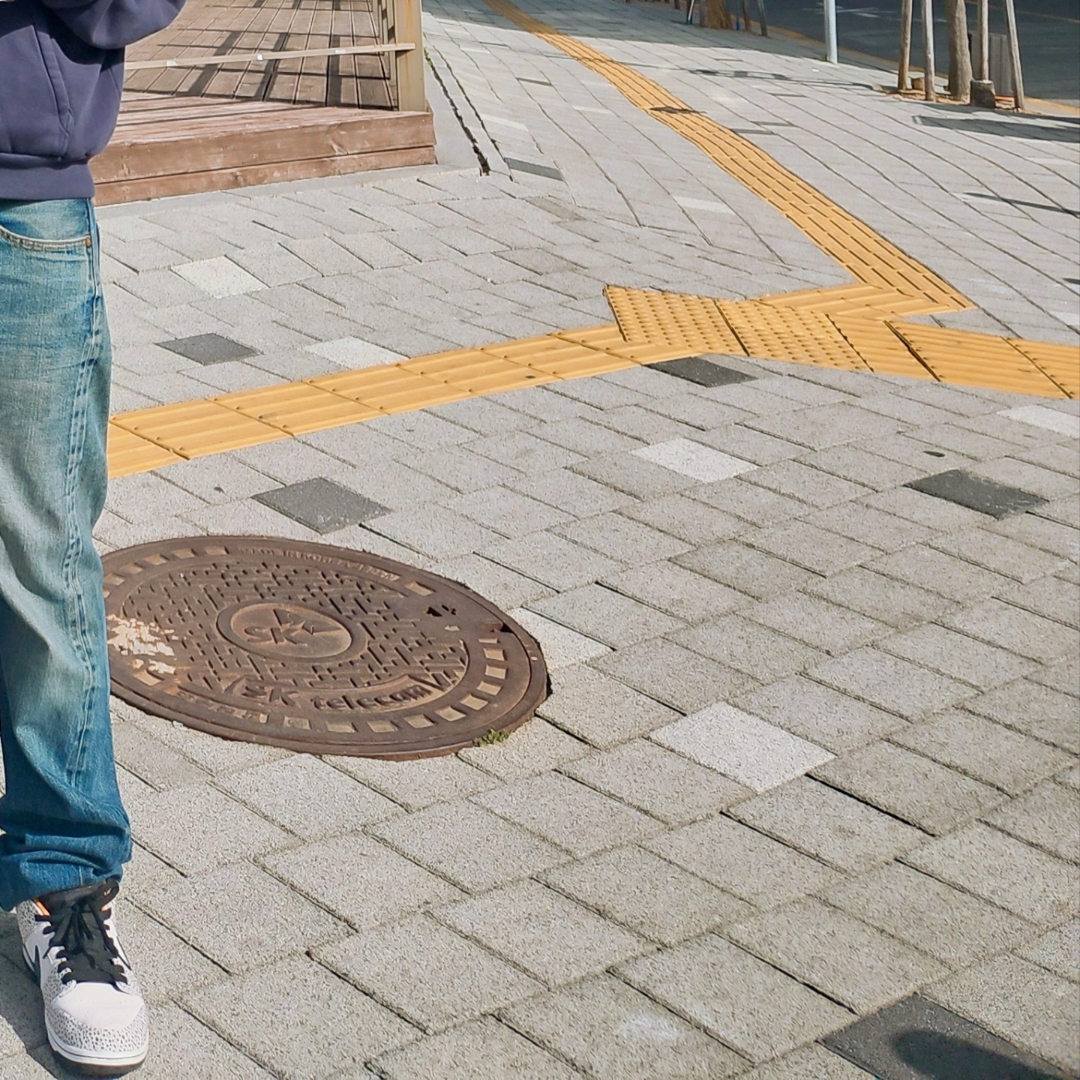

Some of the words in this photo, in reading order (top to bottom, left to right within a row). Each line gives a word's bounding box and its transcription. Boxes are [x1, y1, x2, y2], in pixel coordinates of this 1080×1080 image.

[244, 626, 302, 646] SK
[241, 683, 302, 708] SK
[310, 684, 434, 711] telecom
